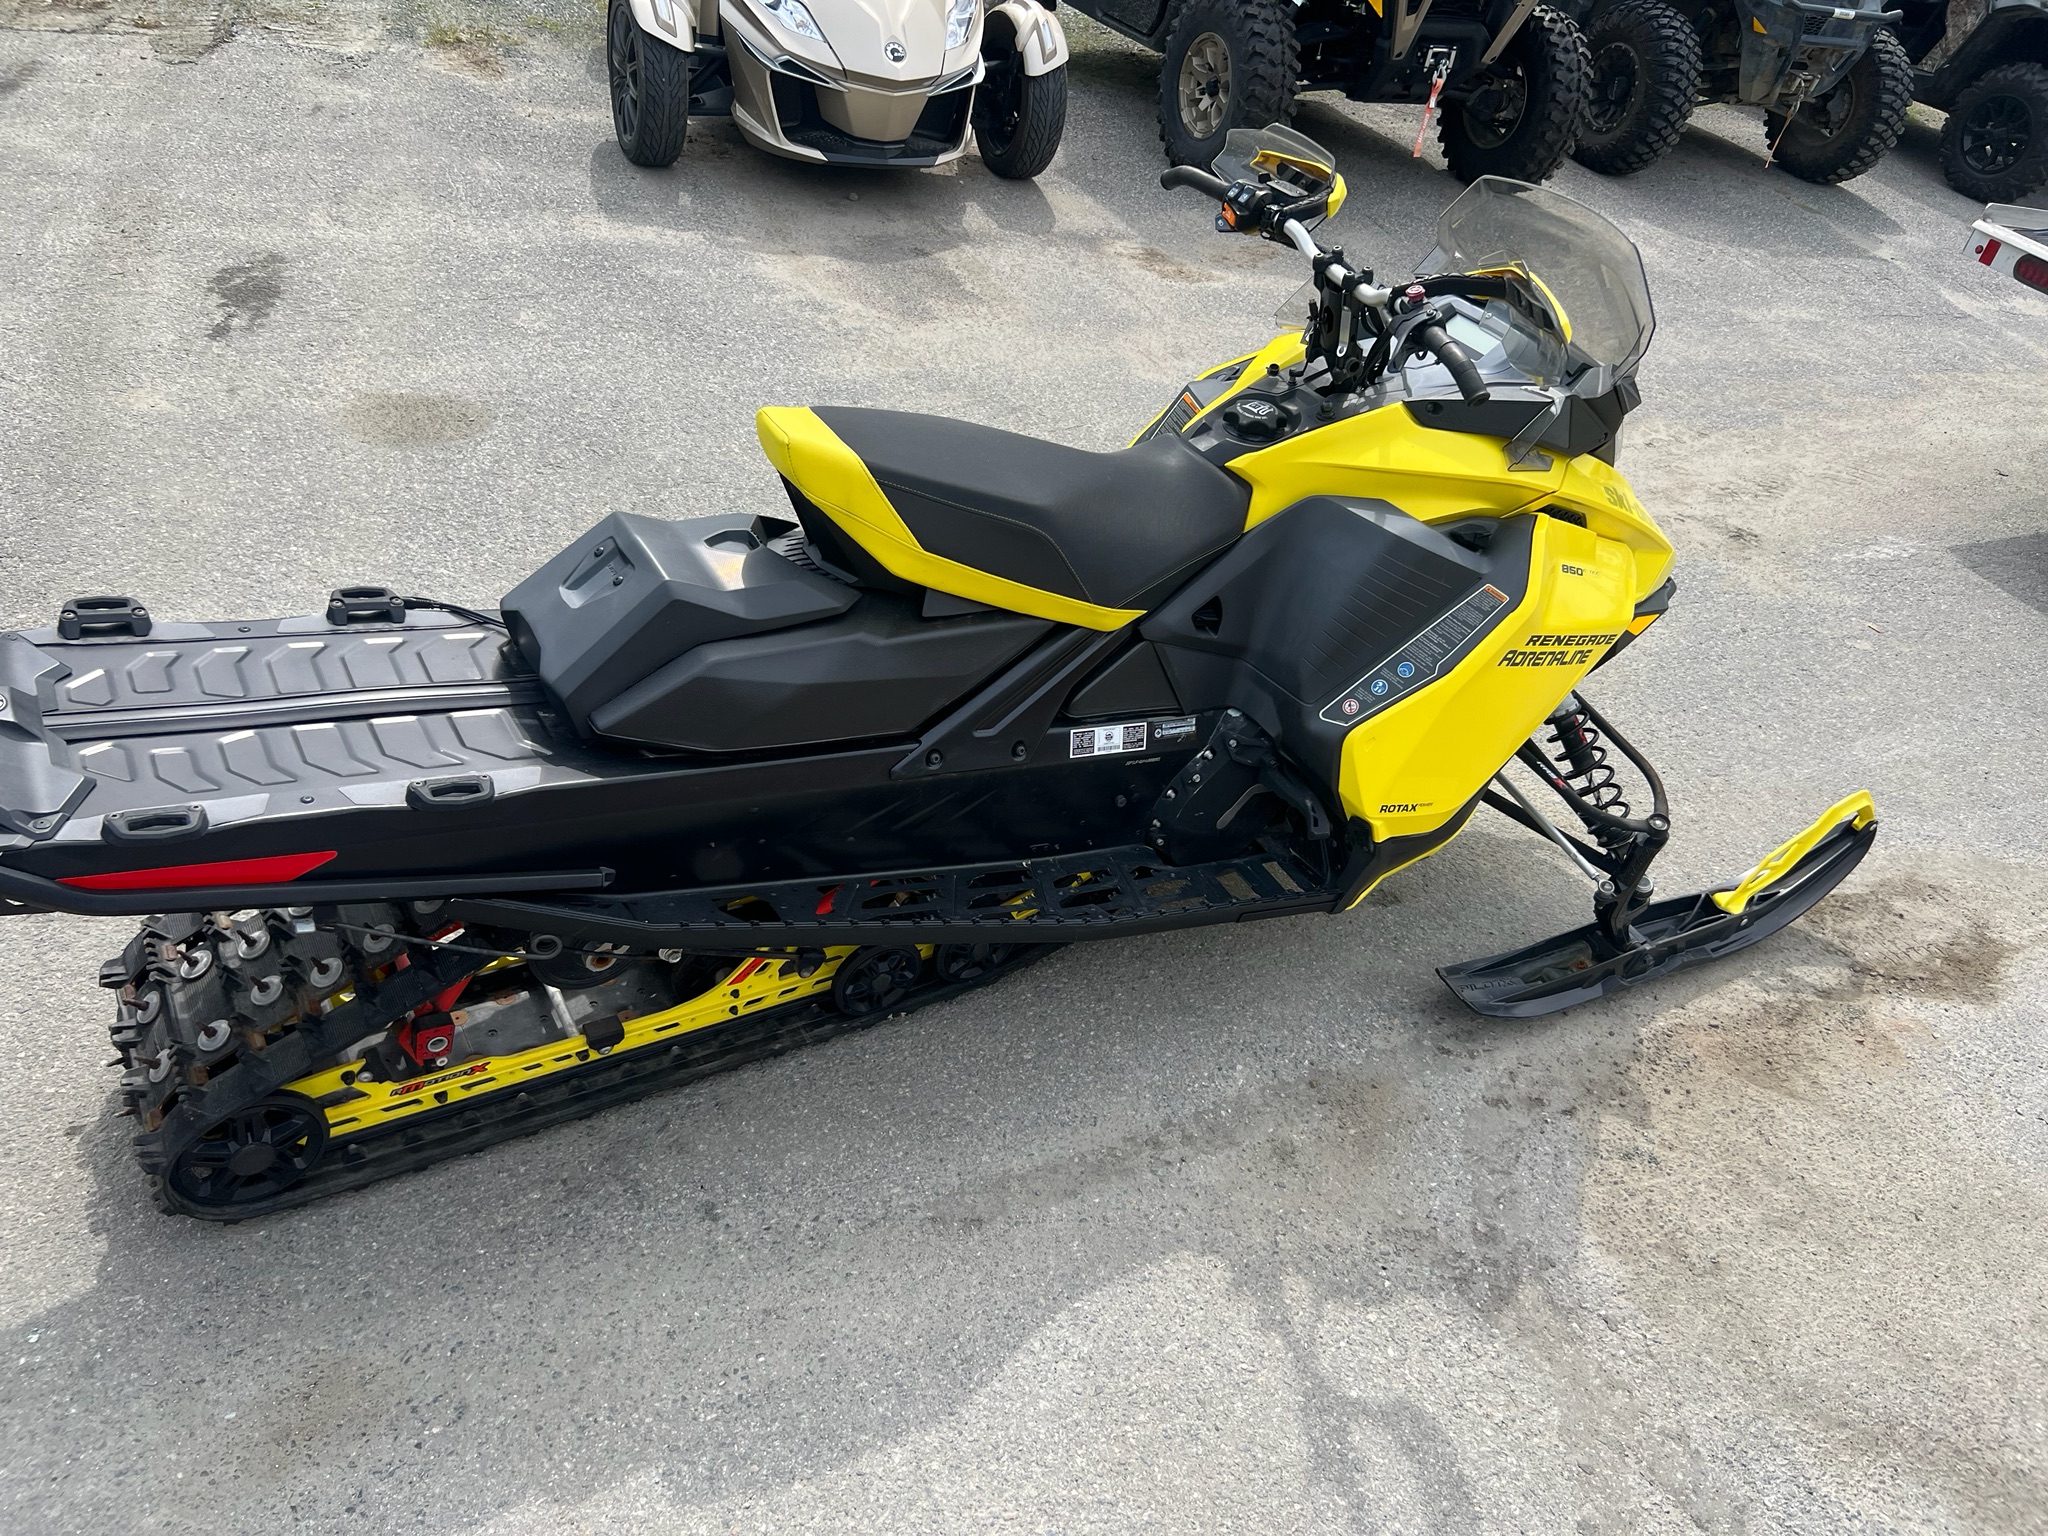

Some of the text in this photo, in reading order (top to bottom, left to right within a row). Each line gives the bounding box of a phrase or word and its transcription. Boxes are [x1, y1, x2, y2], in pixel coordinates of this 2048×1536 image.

[1561, 564, 1584, 577] 850
[1525, 634, 1618, 647] RENEGADE
[1497, 649, 1594, 667] ADRENALINE
[1379, 803, 1418, 813] ROTAX
